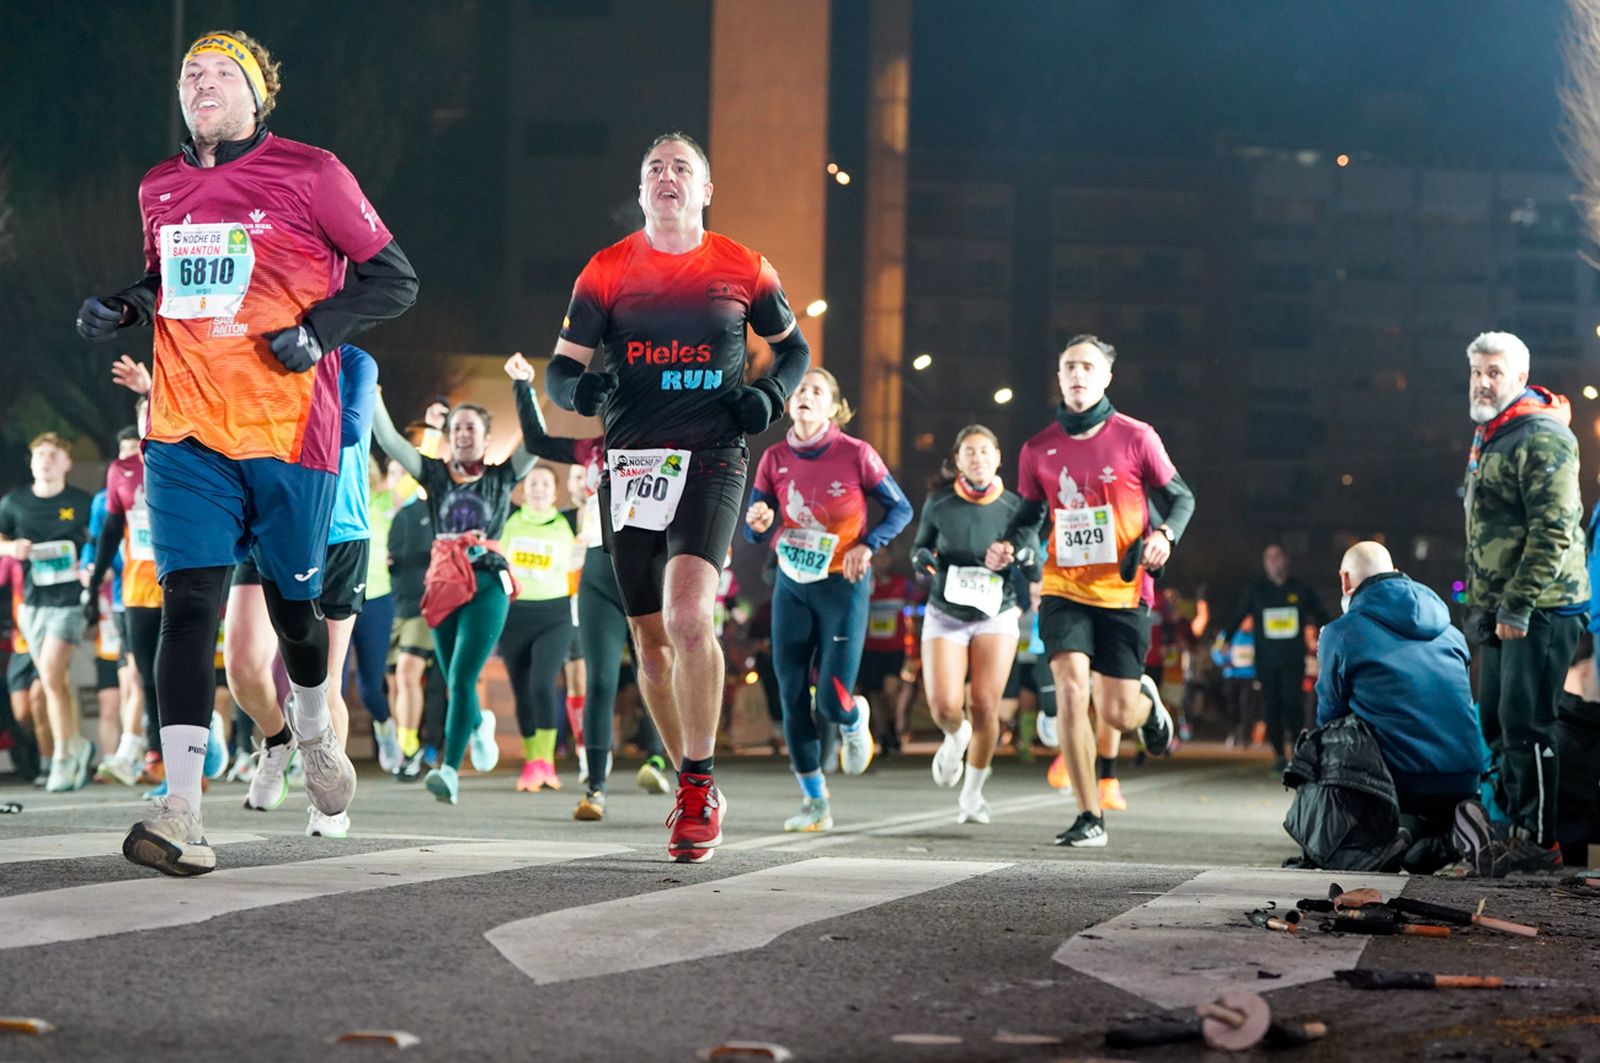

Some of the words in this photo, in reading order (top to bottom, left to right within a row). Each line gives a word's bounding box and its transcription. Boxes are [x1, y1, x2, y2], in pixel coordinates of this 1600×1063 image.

[183, 234, 209, 243] NOCHE
[210, 234, 221, 243] DE
[173, 246, 189, 256] SAN
[180, 257, 234, 286] 6810
[626, 339, 712, 365] Pieles
[661, 369, 723, 390] RUN
[1064, 527, 1104, 547] 3429
